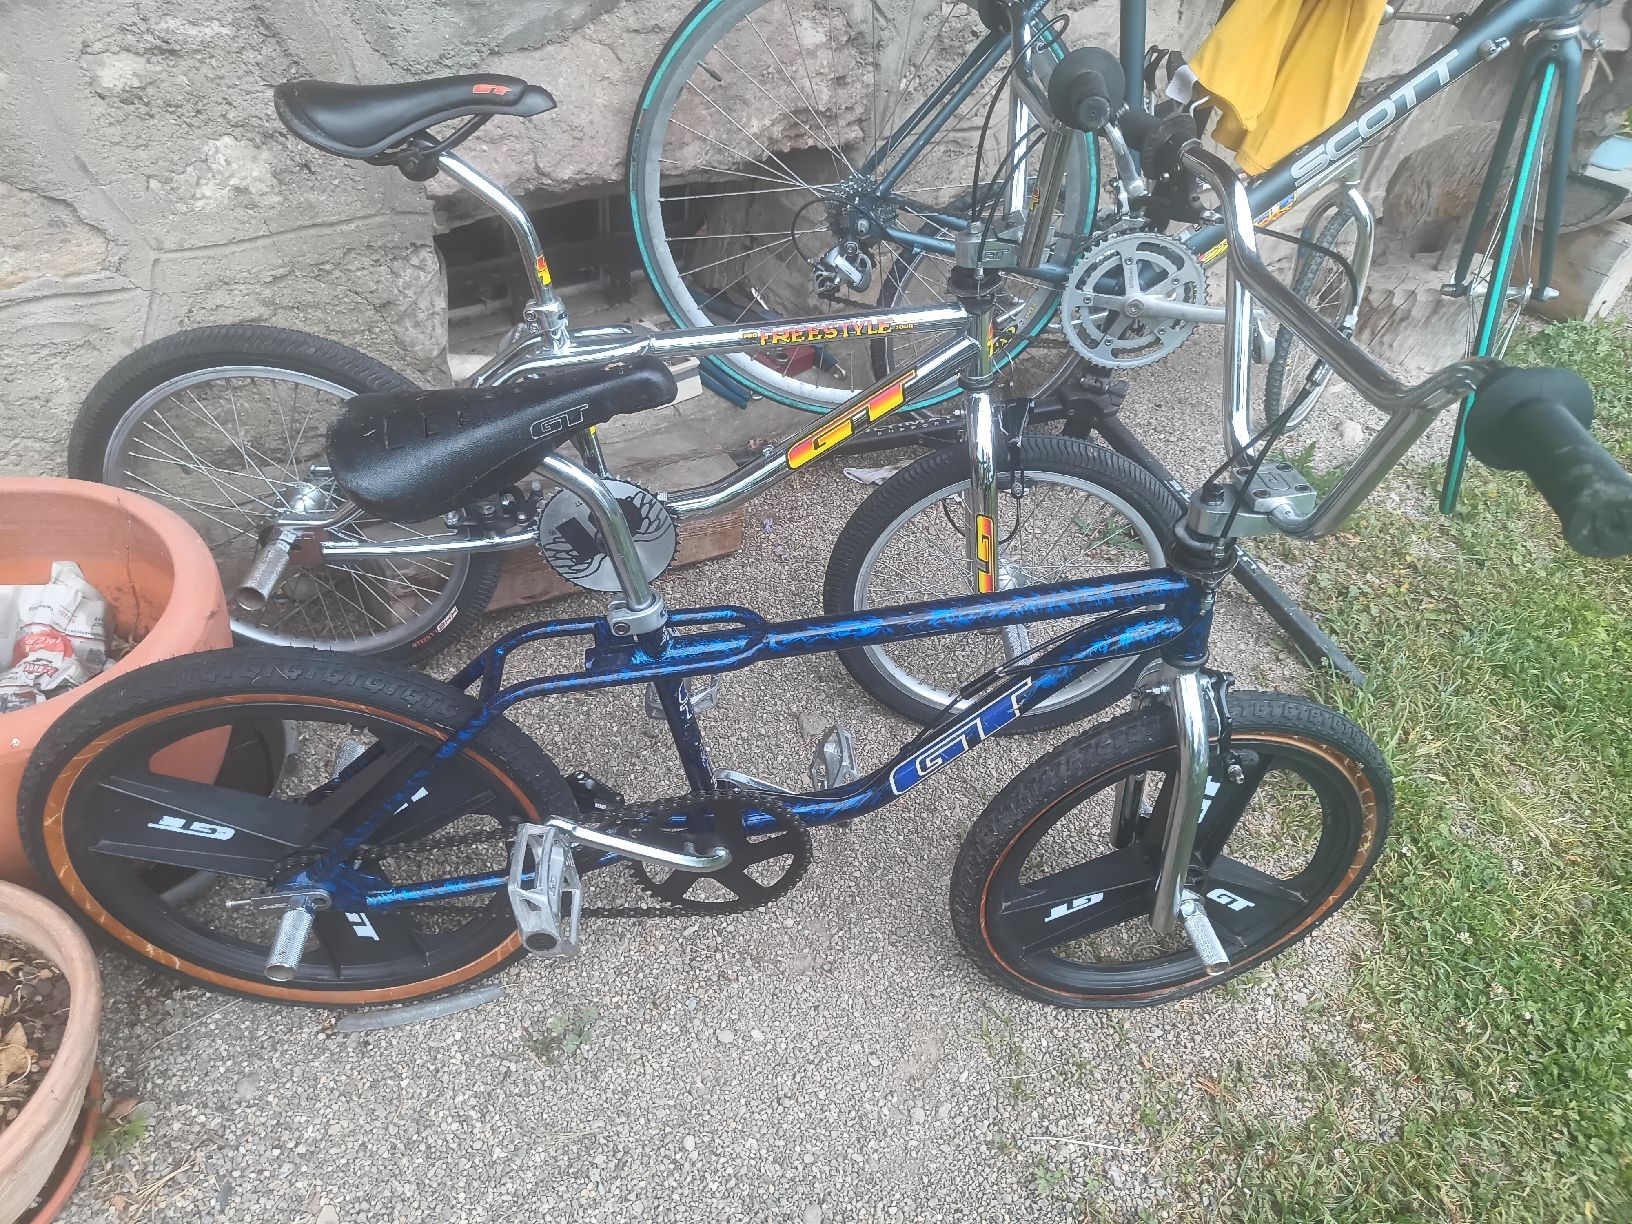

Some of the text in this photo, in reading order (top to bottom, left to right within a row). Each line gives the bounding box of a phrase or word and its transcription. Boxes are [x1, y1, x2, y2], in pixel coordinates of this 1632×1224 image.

[1291, 48, 1459, 187] SCOTT
[759, 317, 894, 346] FREESTYLE
[530, 404, 588, 439] GT
[787, 370, 916, 469] GT
[889, 676, 1032, 795] GT
[147, 816, 235, 840] GT
[1207, 888, 1255, 911] GT
